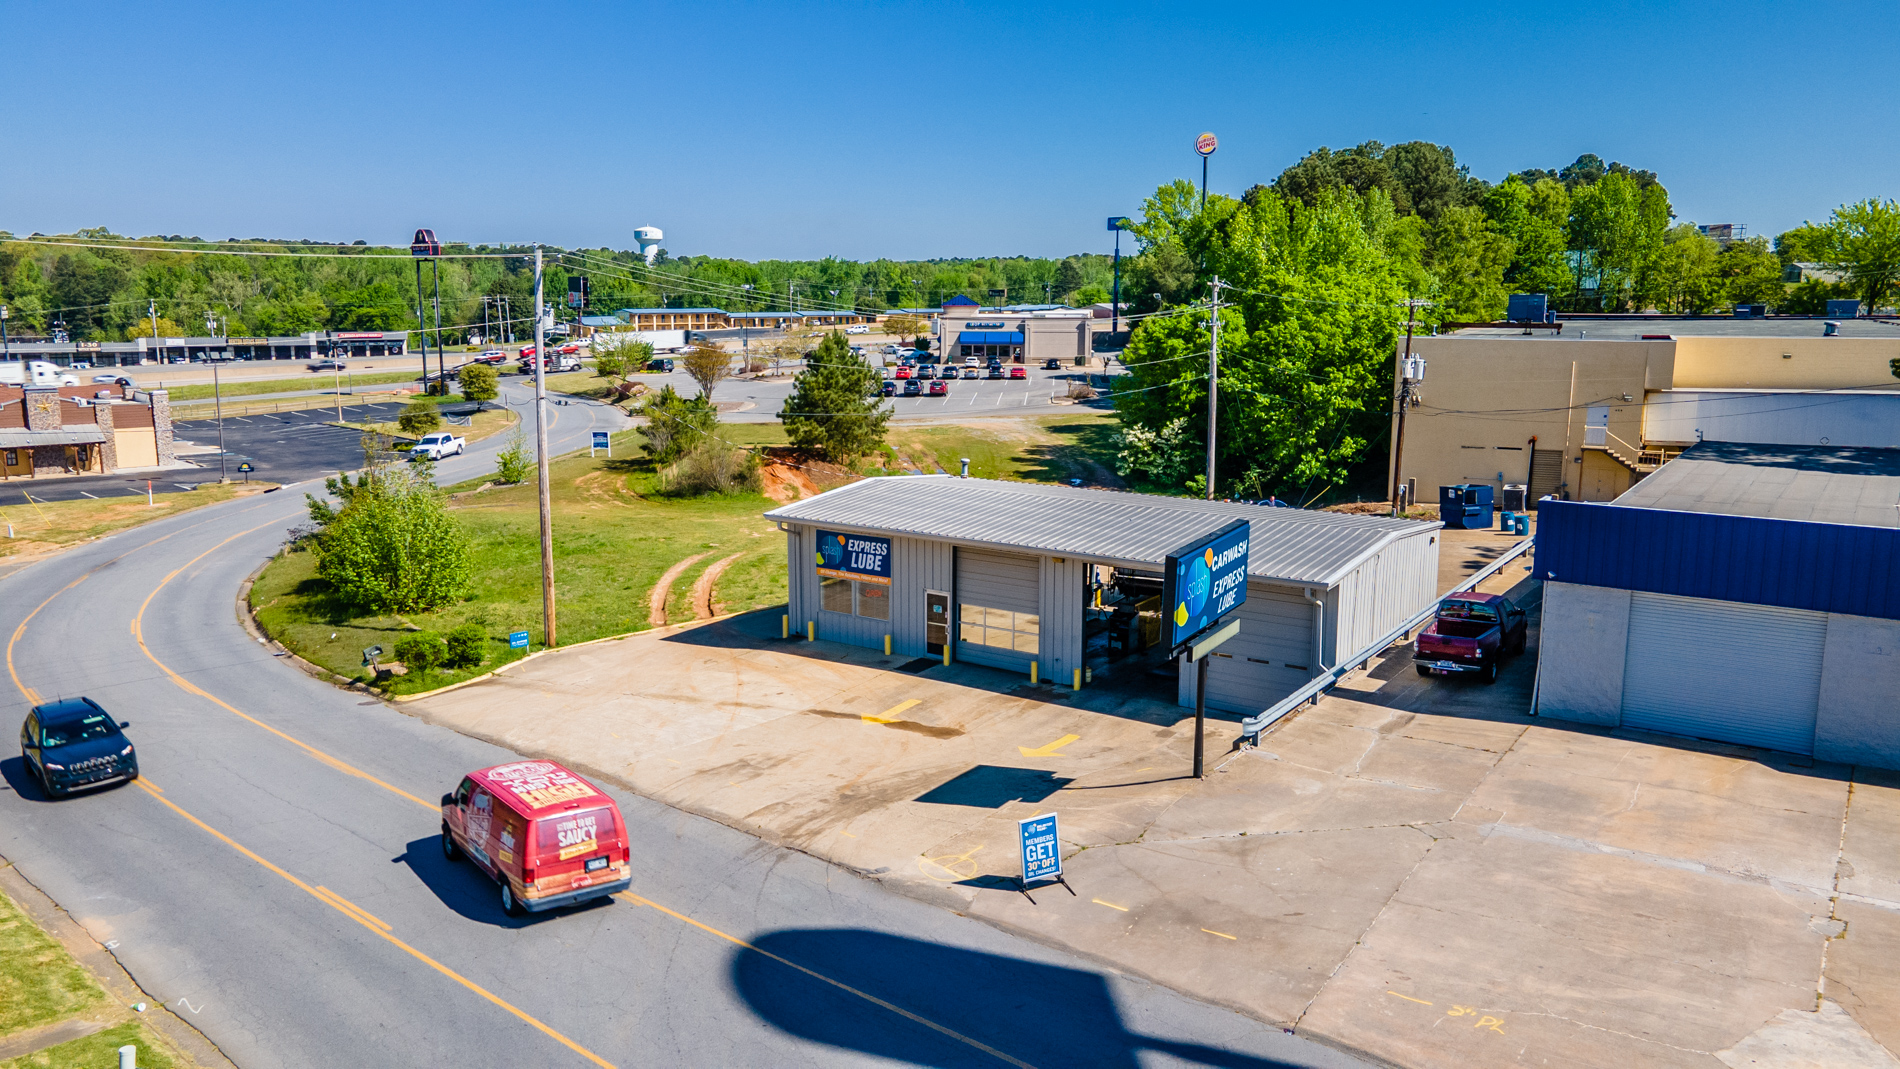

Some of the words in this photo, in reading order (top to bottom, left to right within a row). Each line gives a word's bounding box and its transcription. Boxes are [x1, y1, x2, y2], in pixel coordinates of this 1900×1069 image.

[1198, 140, 1216, 150] KING
[848, 539, 888, 556] EXPRESS
[1212, 539, 1248, 572] CARWASH
[851, 552, 882, 571] LUBE
[1212, 565, 1245, 598] EXPRESS
[1218, 588, 1238, 614] LUBE
[510, 780, 552, 794] MUST
[518, 782, 599, 803] HIGH
[558, 824, 597, 847] SAUCY
[1026, 834, 1054, 846] MEMBERS
[1026, 840, 1054, 862] GET
[1042, 857, 1055, 868] OFF
